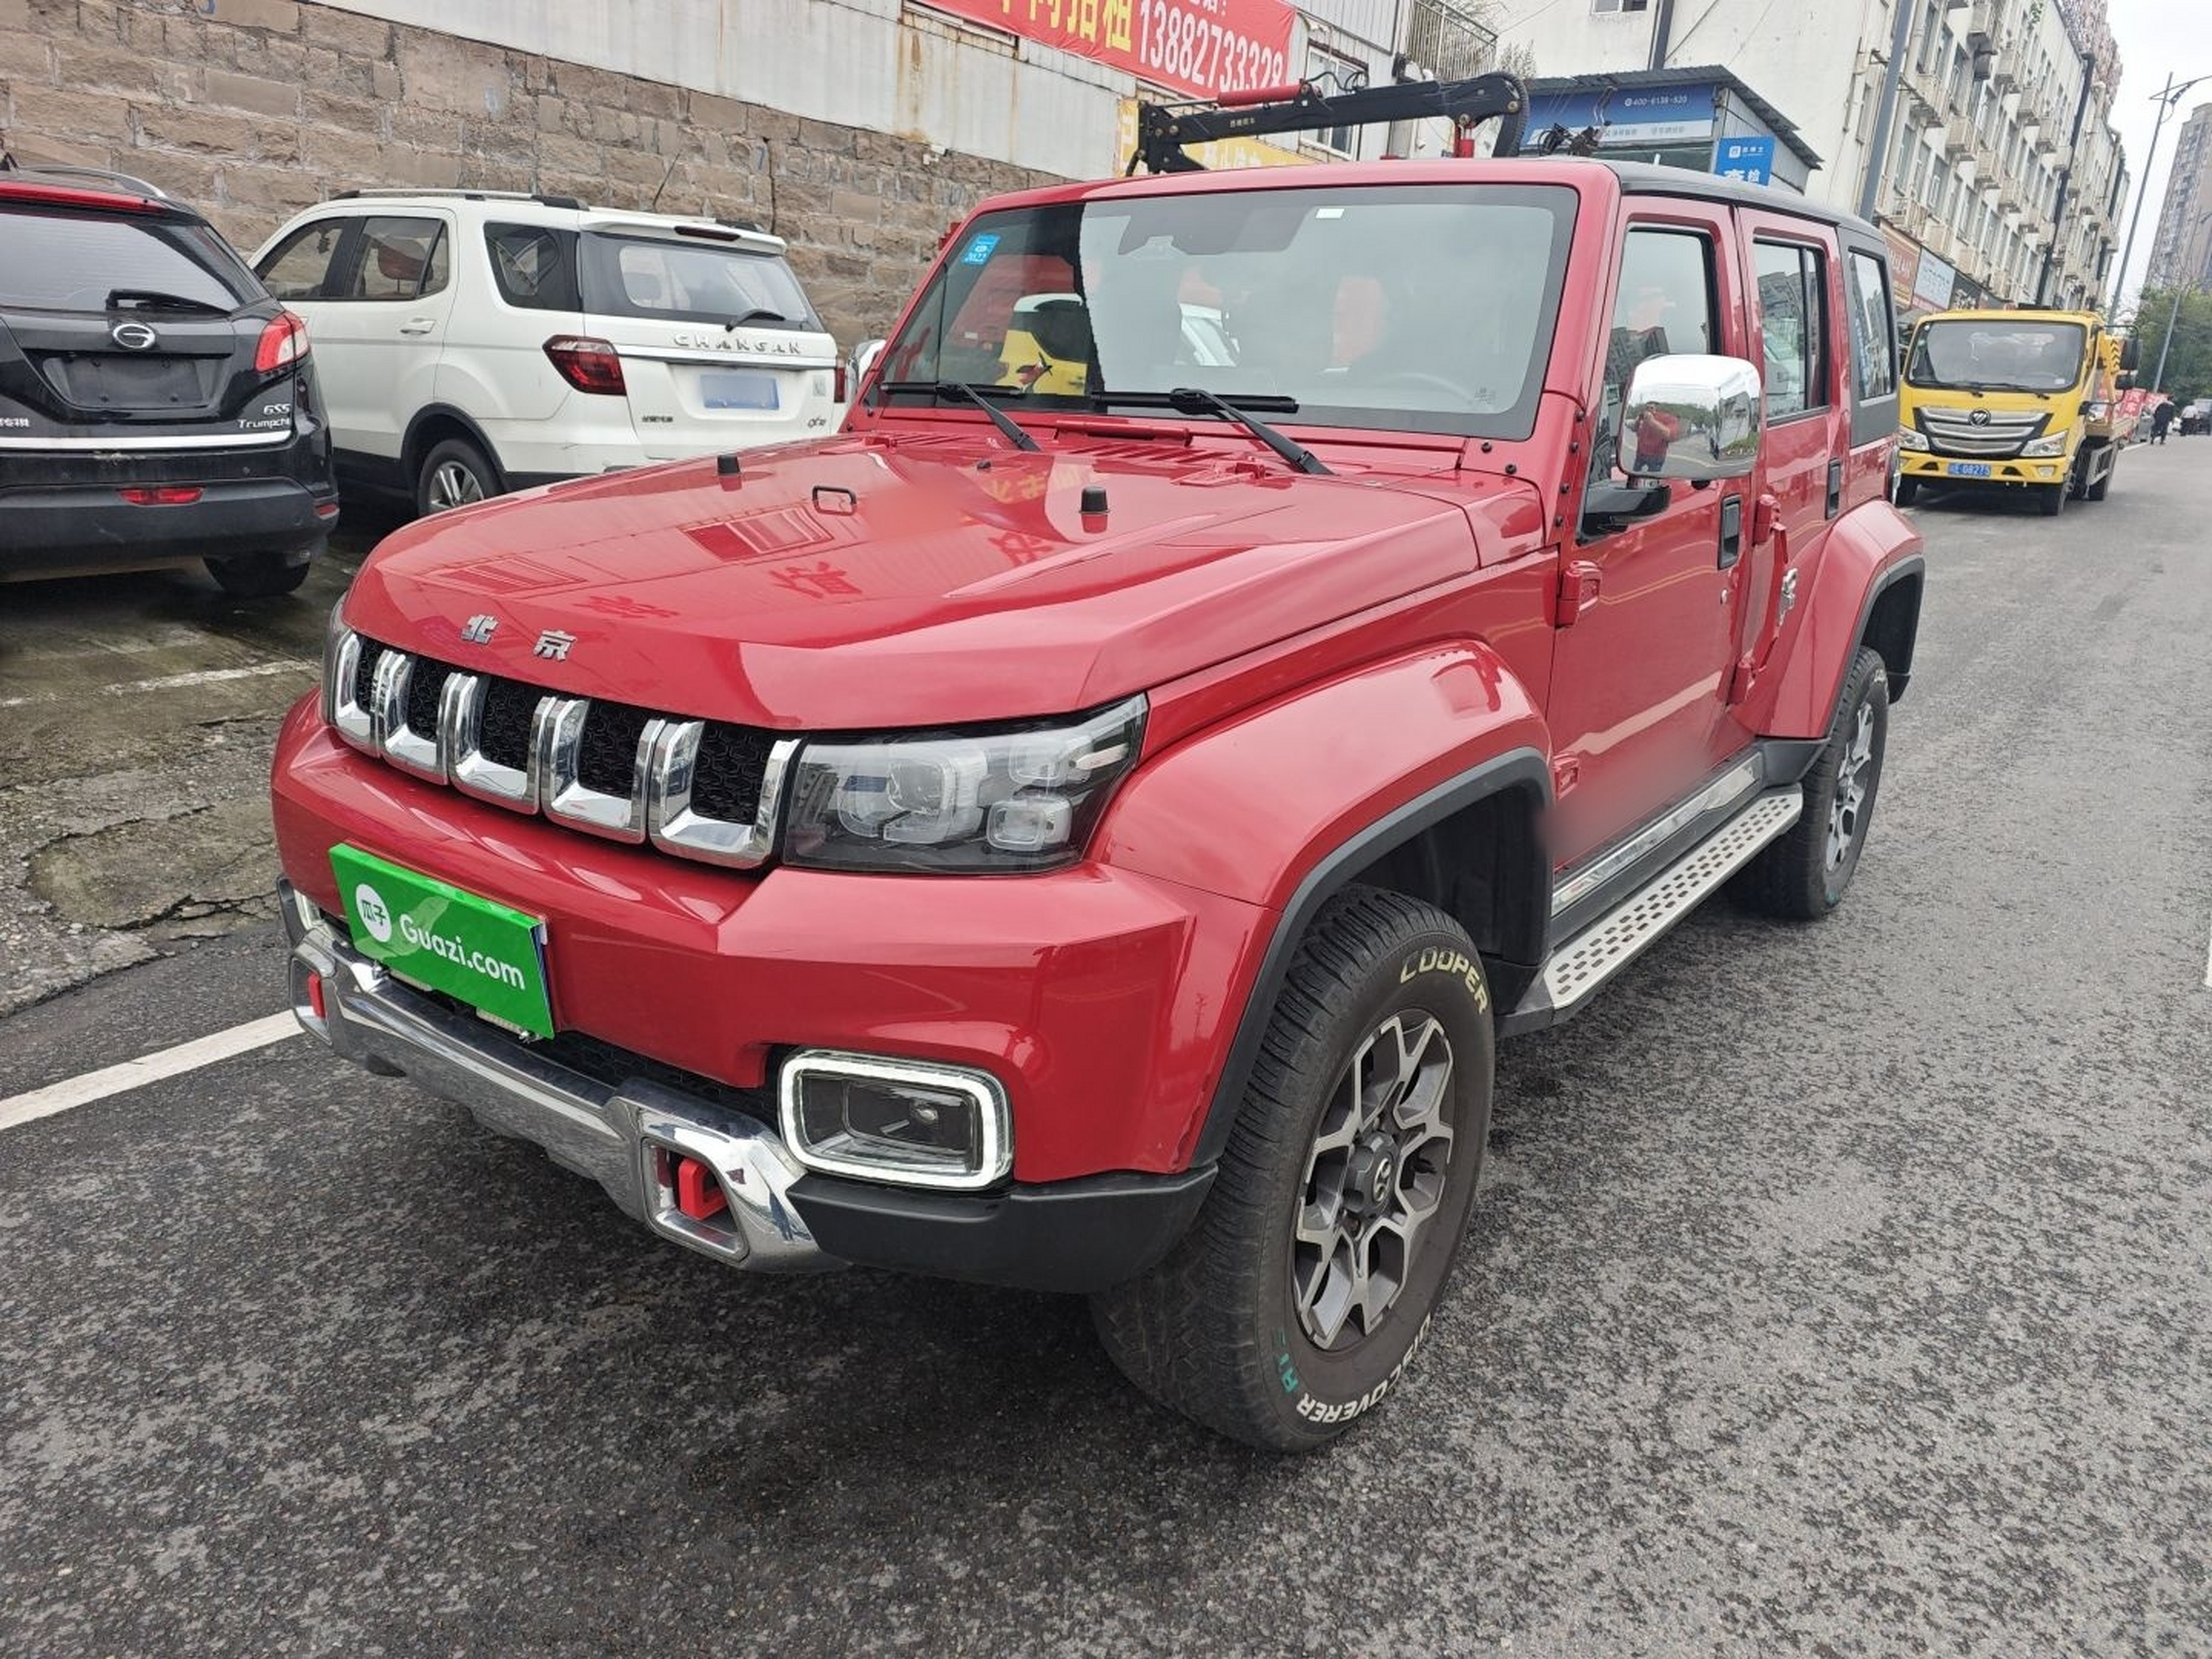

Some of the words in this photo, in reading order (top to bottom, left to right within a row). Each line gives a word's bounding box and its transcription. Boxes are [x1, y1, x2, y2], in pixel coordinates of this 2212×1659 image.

[1139, 0, 1283, 92] 13882733328
[461, 614, 577, 662] 北京
[361, 899, 387, 927] 瓜子
[399, 913, 526, 991] Guazi.com
[1400, 946, 1487, 1015] COOPER
